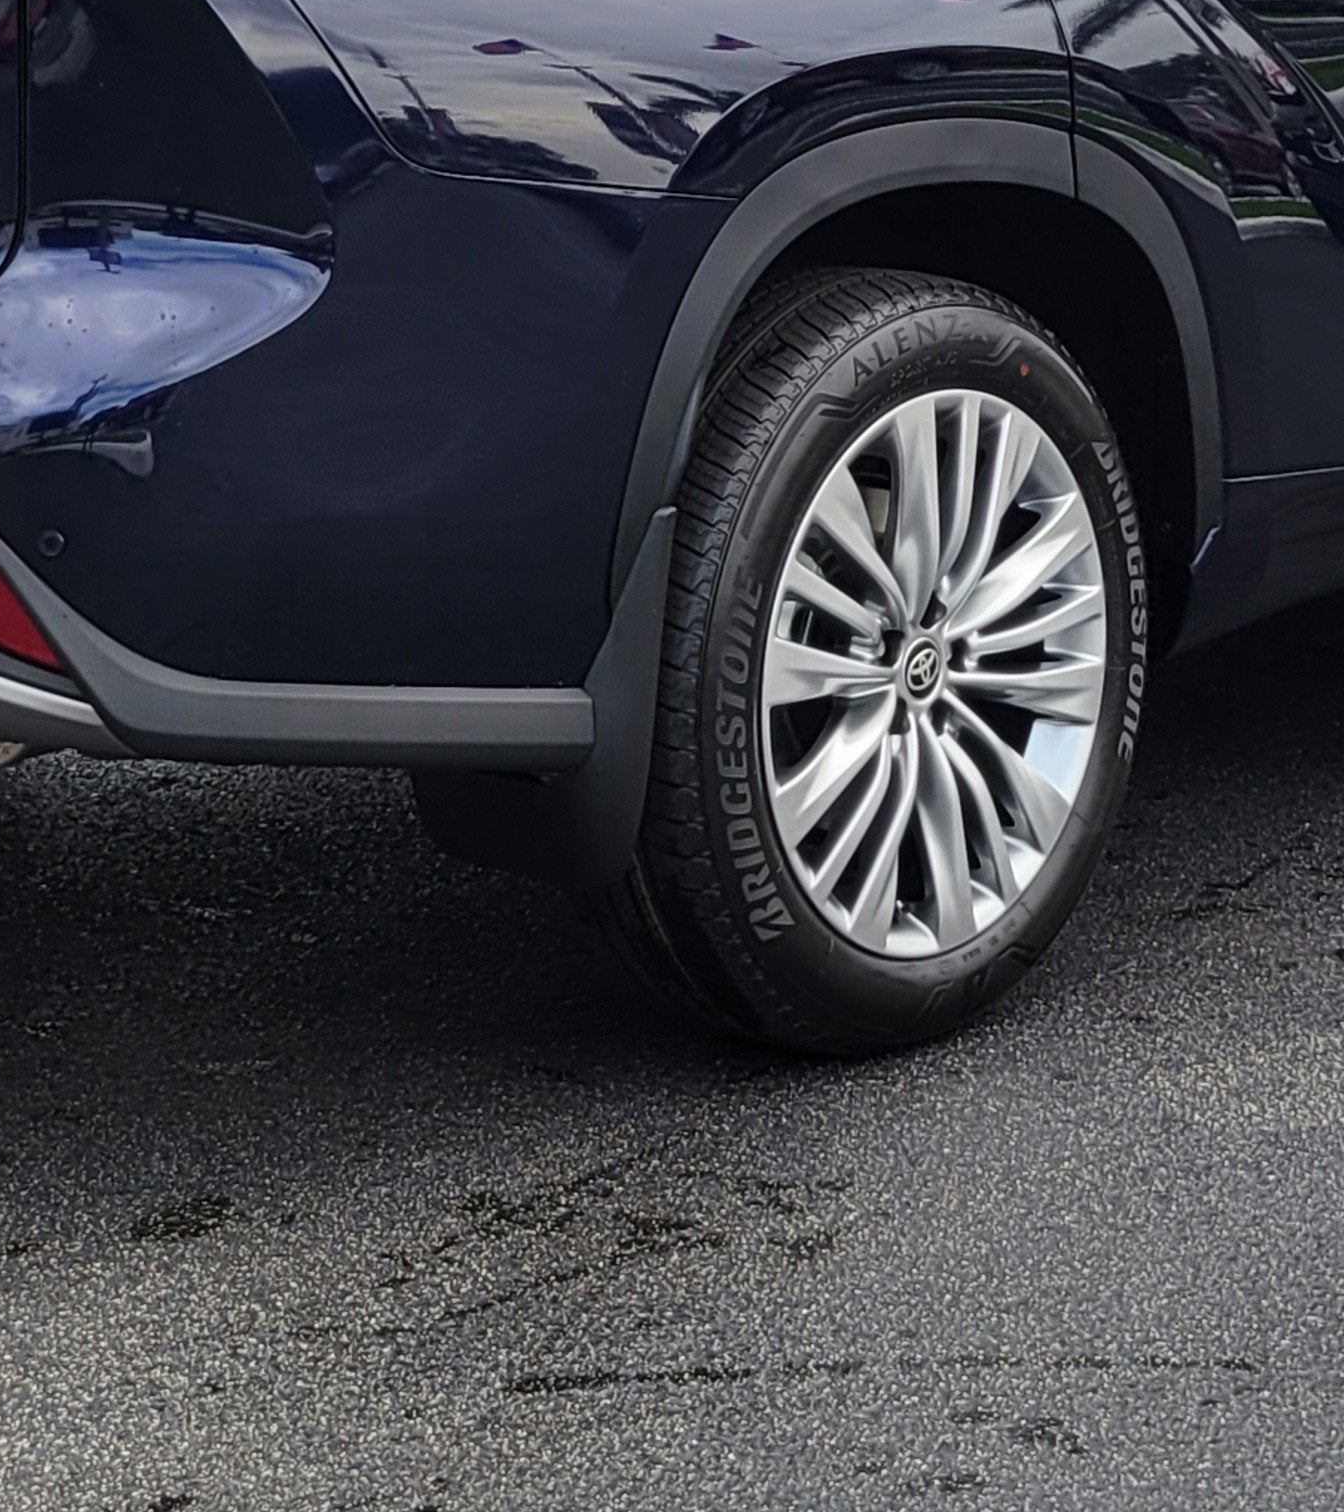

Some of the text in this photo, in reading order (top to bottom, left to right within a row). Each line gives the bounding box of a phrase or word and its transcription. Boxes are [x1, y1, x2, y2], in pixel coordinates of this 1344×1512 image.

[852, 313, 986, 388] ALENZ
[714, 565, 795, 941] BRIDGESTONE
[1091, 441, 1148, 763] BRIDGESTONE
